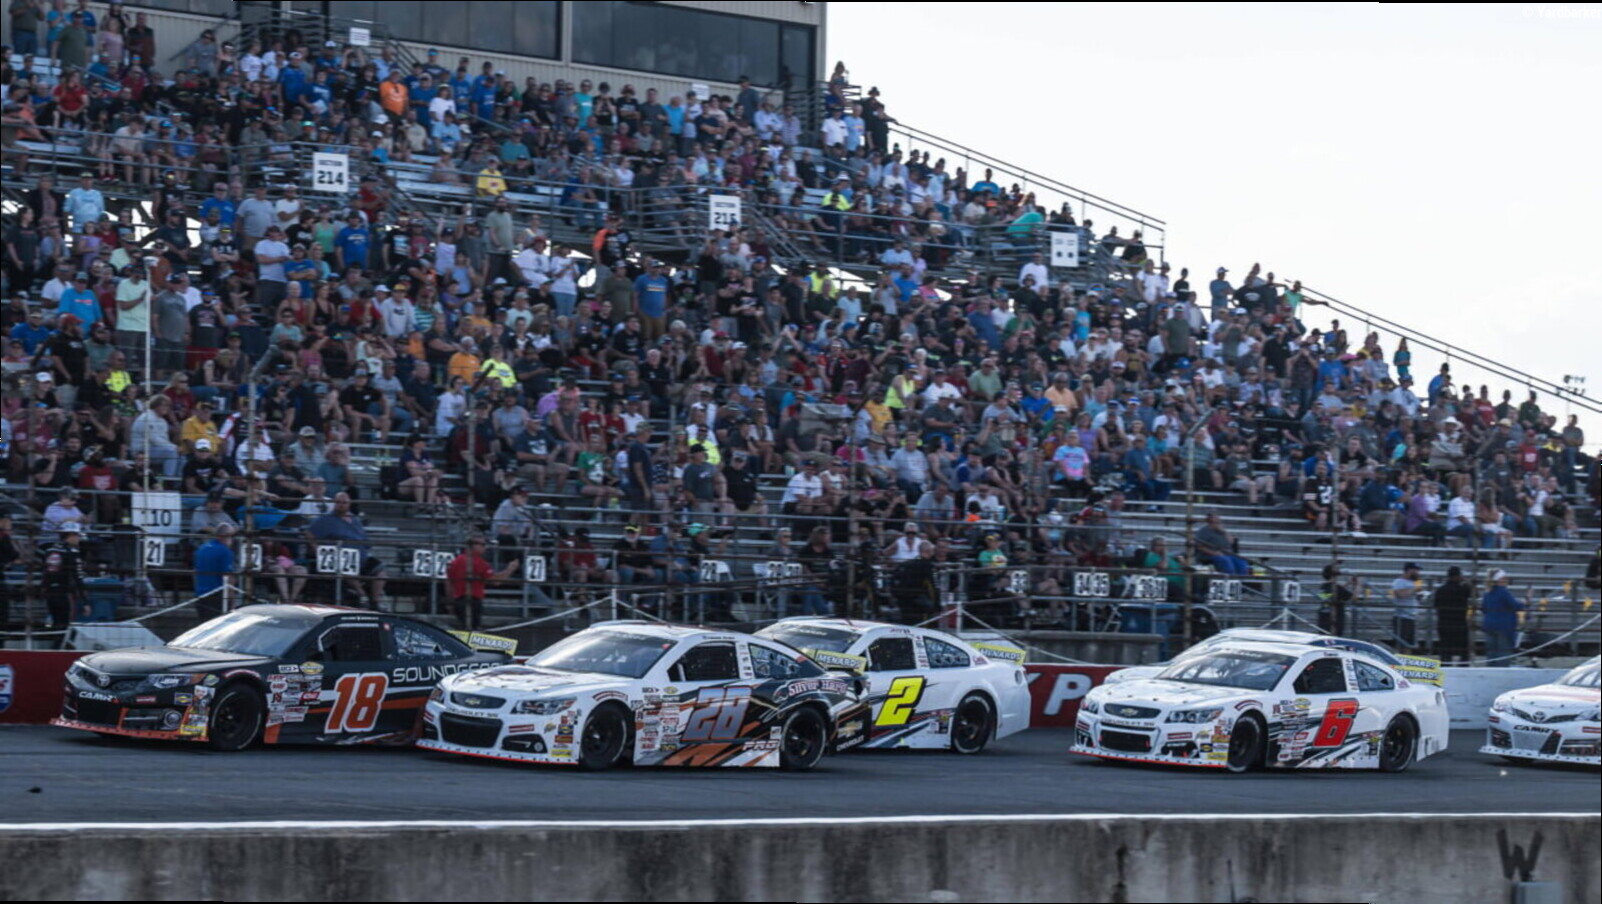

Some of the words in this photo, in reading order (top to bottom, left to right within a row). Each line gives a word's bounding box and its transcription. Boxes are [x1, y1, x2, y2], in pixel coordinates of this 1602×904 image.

[318, 170, 344, 185] 214
[323, 672, 389, 734] 18
[681, 686, 751, 741] 28
[874, 676, 925, 727] 2
[1313, 698, 1359, 748] 6
